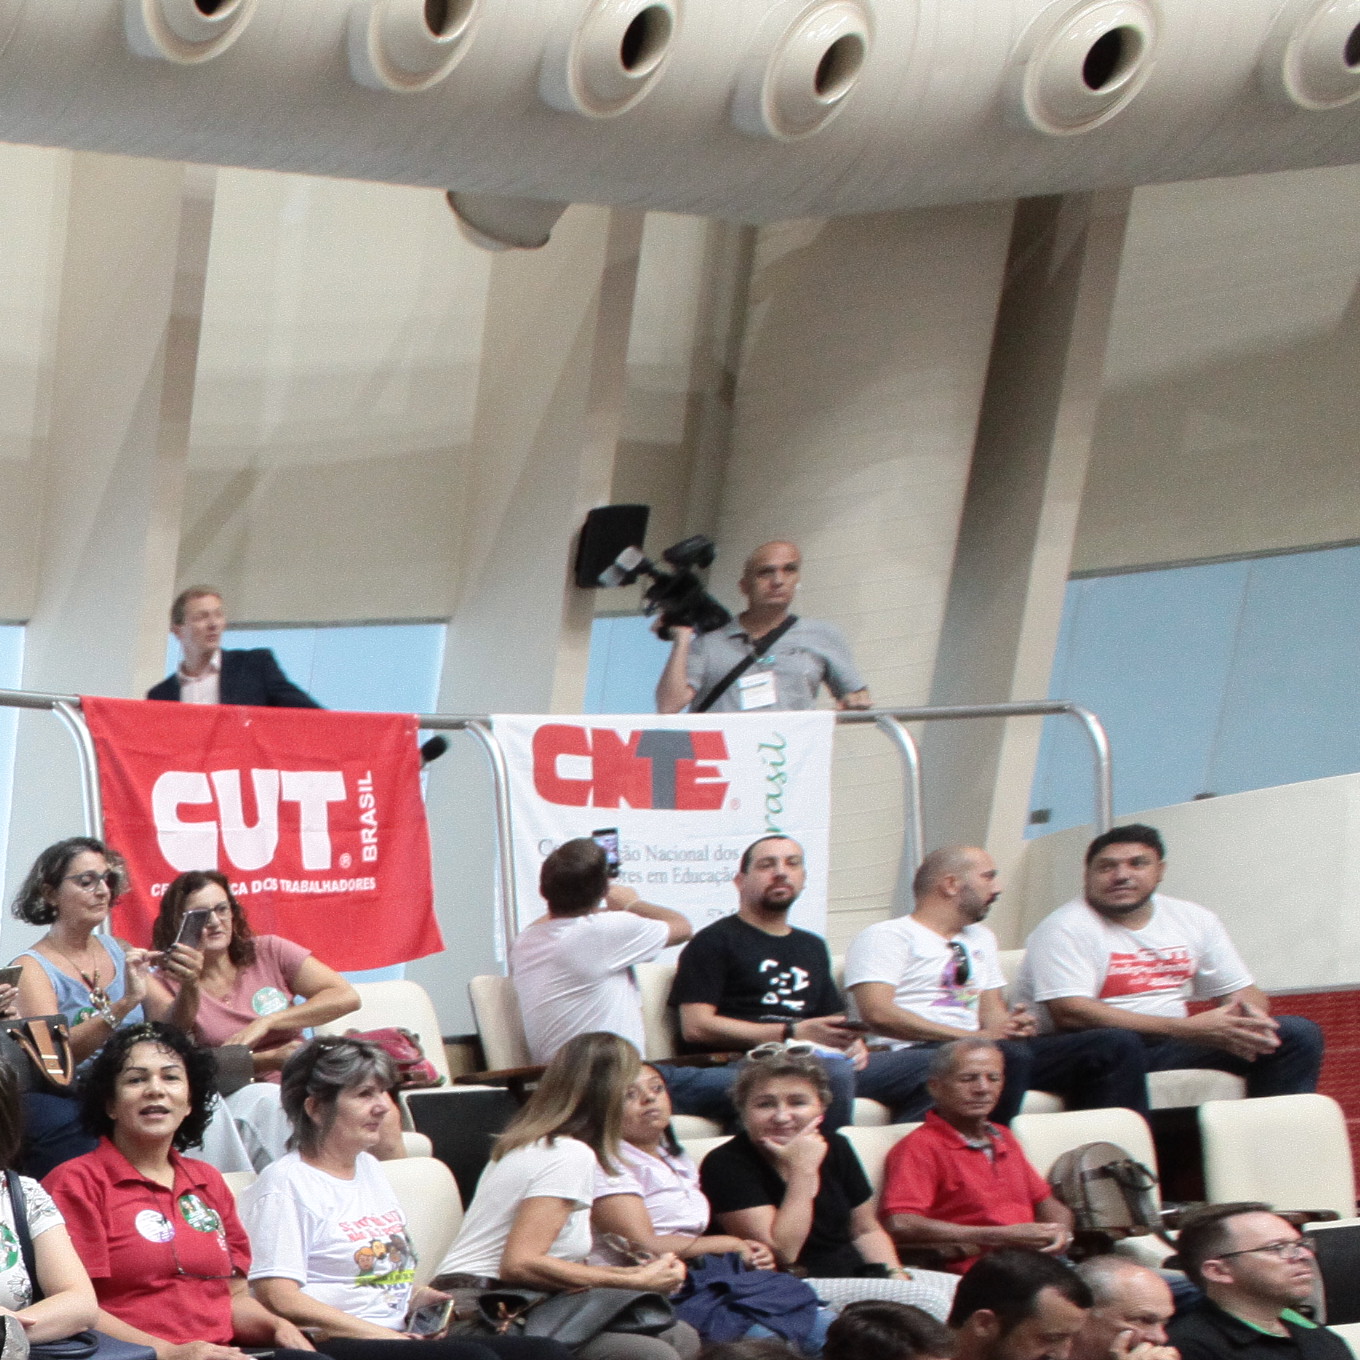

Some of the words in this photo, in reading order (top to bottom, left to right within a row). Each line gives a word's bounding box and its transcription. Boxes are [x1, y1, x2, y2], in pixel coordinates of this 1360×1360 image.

[532, 724, 730, 811] CNTE
[756, 731, 787, 833] rasil
[152, 768, 347, 872] CUT
[357, 770, 378, 863] BRASIL
[645, 845, 709, 861] Nacional
[713, 845, 740, 861] dos
[251, 878, 278, 894] DOS
[279, 876, 376, 894] TRABALHADORES
